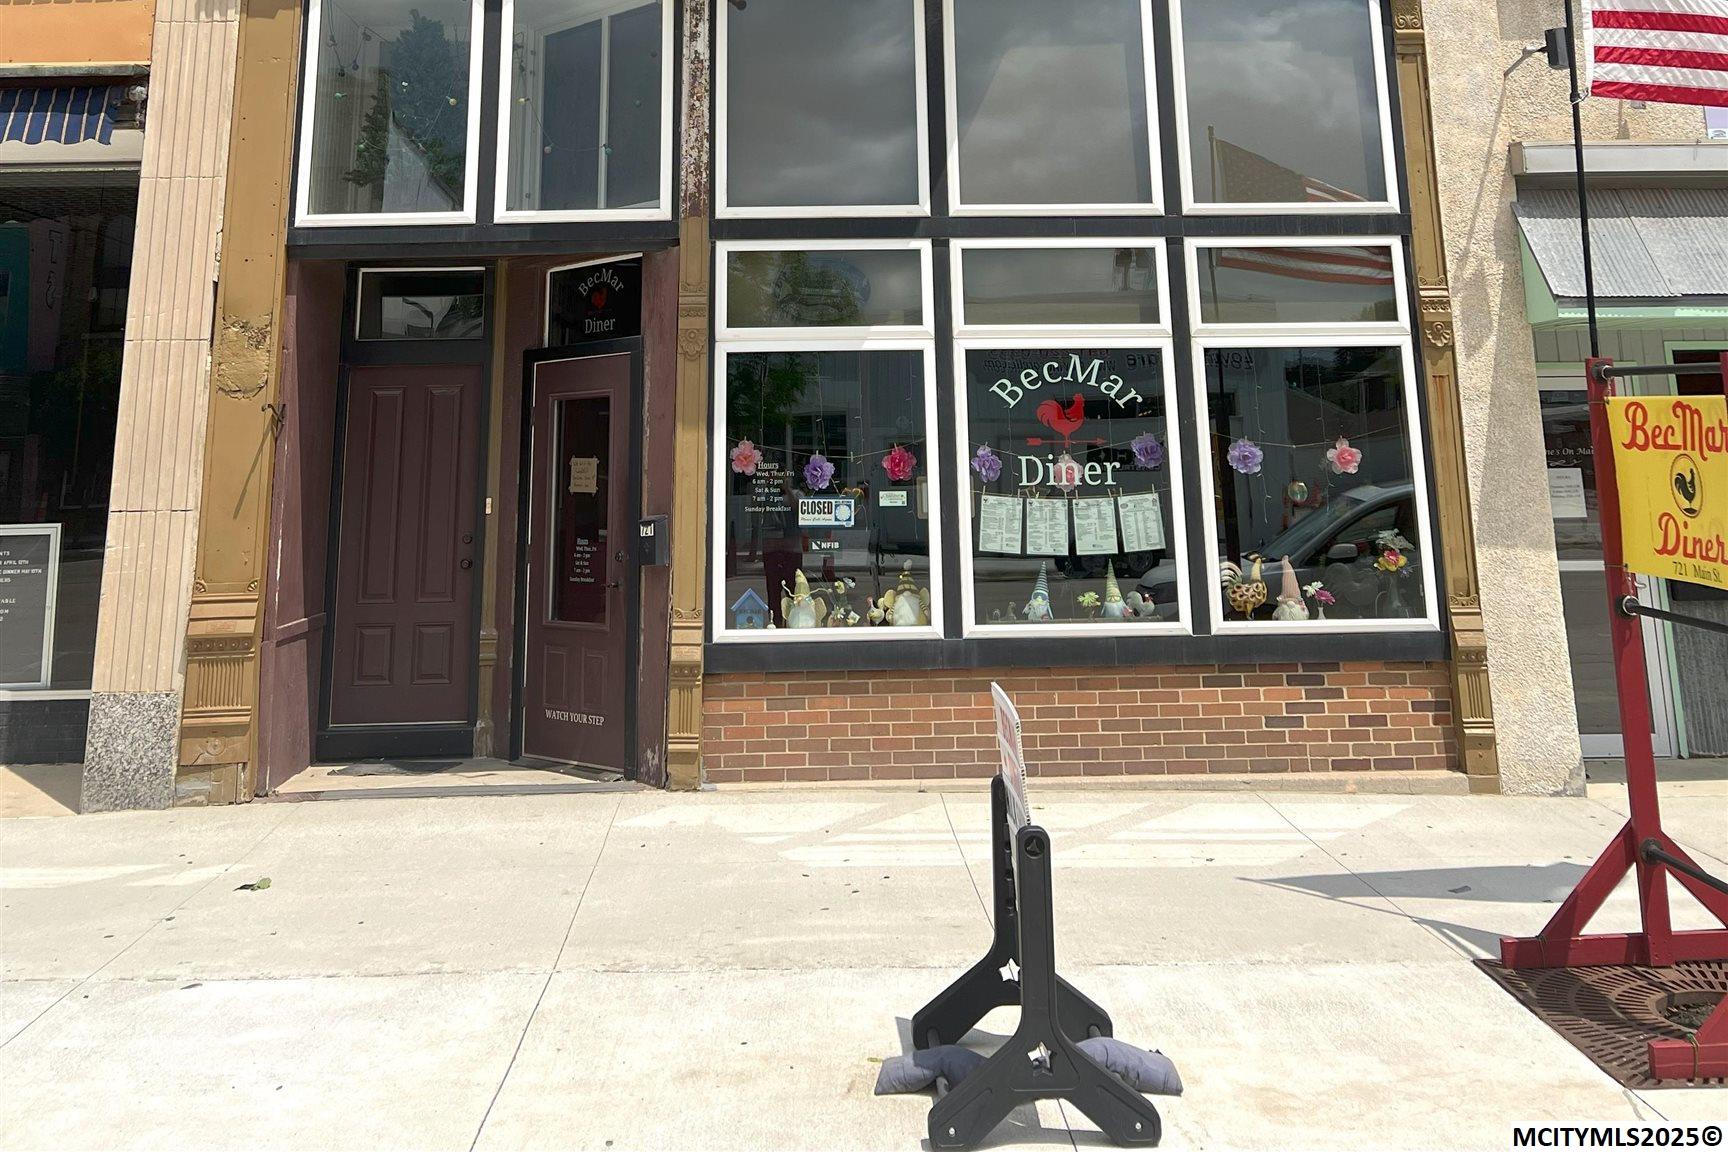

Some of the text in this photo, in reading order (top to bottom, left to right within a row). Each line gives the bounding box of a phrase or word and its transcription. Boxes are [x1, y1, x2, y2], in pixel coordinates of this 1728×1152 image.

[579, 268, 624, 296] BecMar
[585, 317, 616, 334] Diner
[989, 353, 1143, 409] BecMar
[1622, 400, 1728, 461] BecMar
[1018, 454, 1120, 486] Diner
[800, 500, 833, 515] CLOSED
[1654, 512, 1728, 566] Diner
[1672, 561, 1688, 576] 721
[1692, 563, 1713, 581] Main
[545, 709, 605, 726] WATCH YOUR STEP
